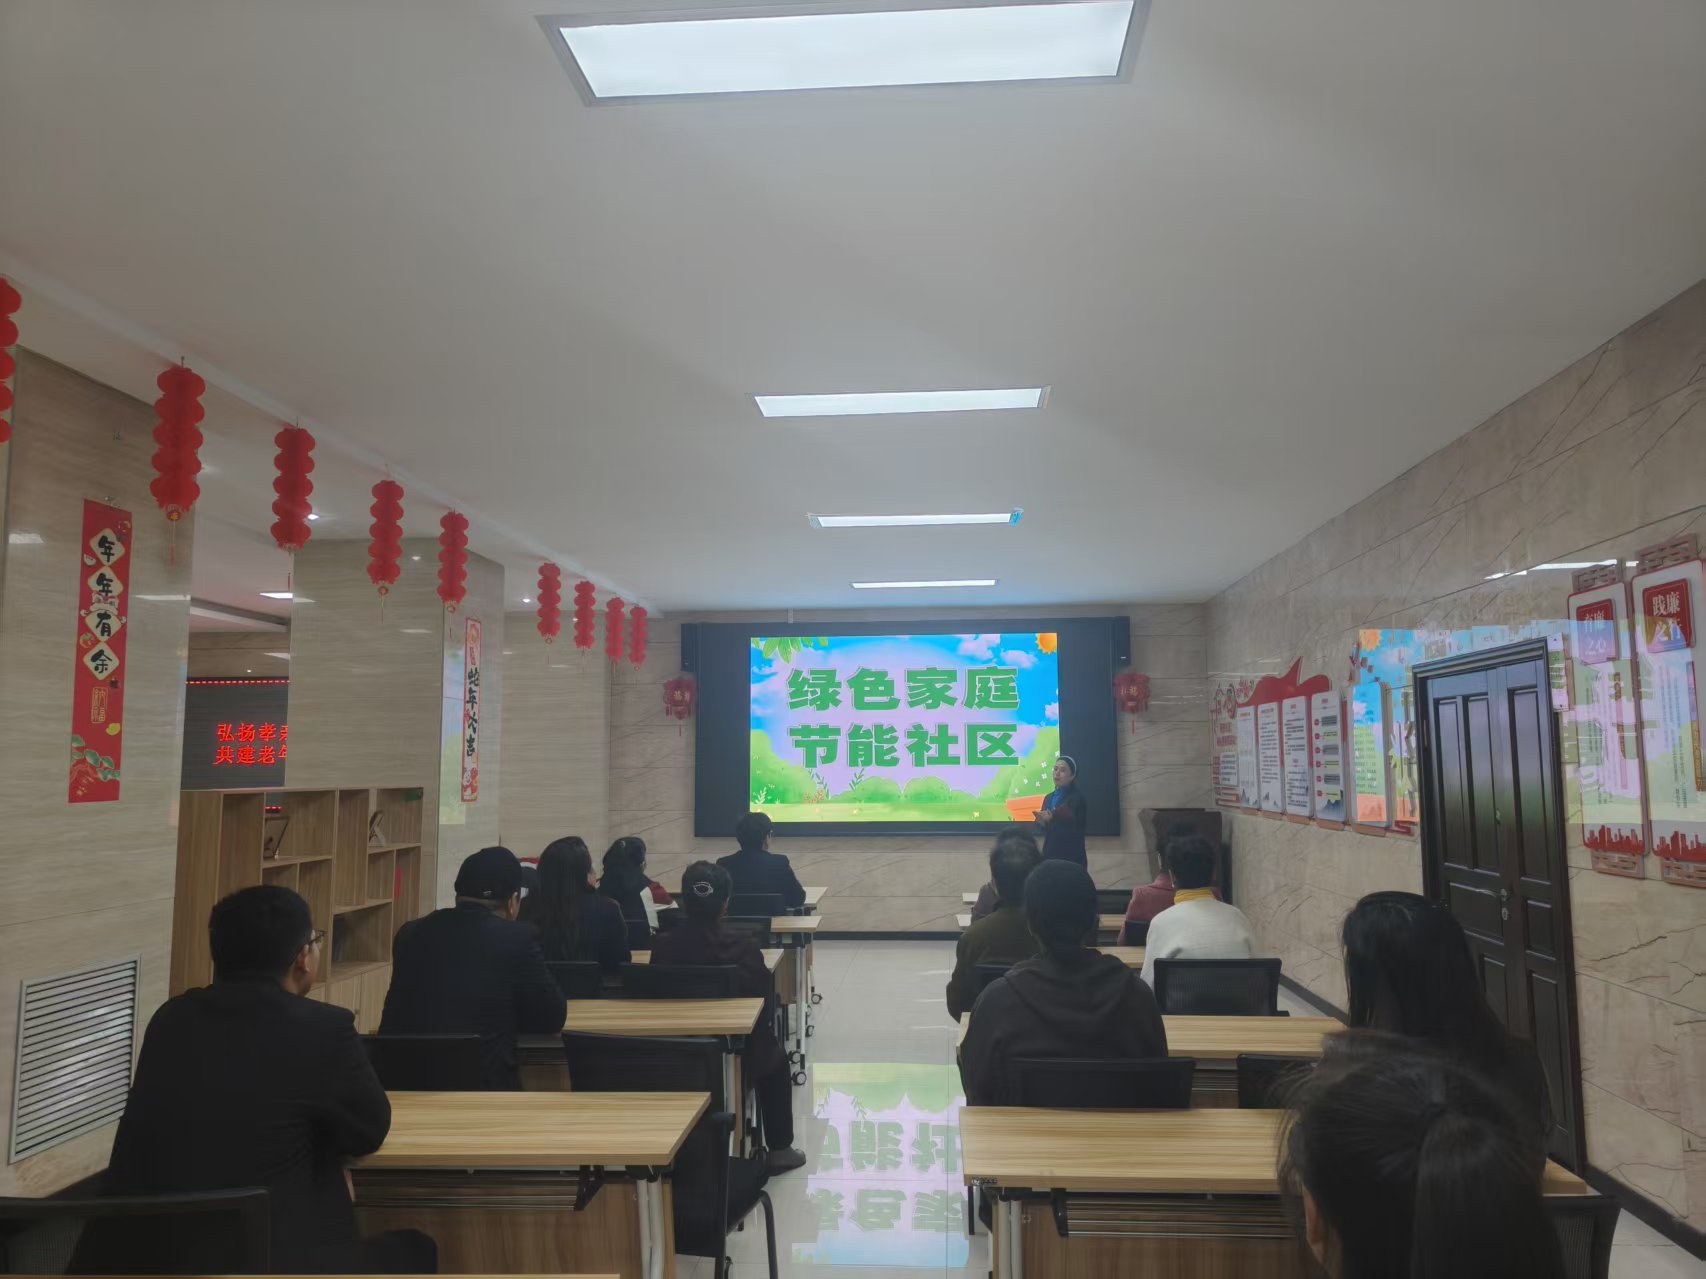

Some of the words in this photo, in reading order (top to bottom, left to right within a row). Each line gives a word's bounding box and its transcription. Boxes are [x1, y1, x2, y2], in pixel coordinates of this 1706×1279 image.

[91, 535, 117, 674] 年年有余
[466, 667, 480, 757] 蛇年大吉
[787, 666, 1020, 711] 绿色家庭
[788, 723, 1020, 768] 节能社区
